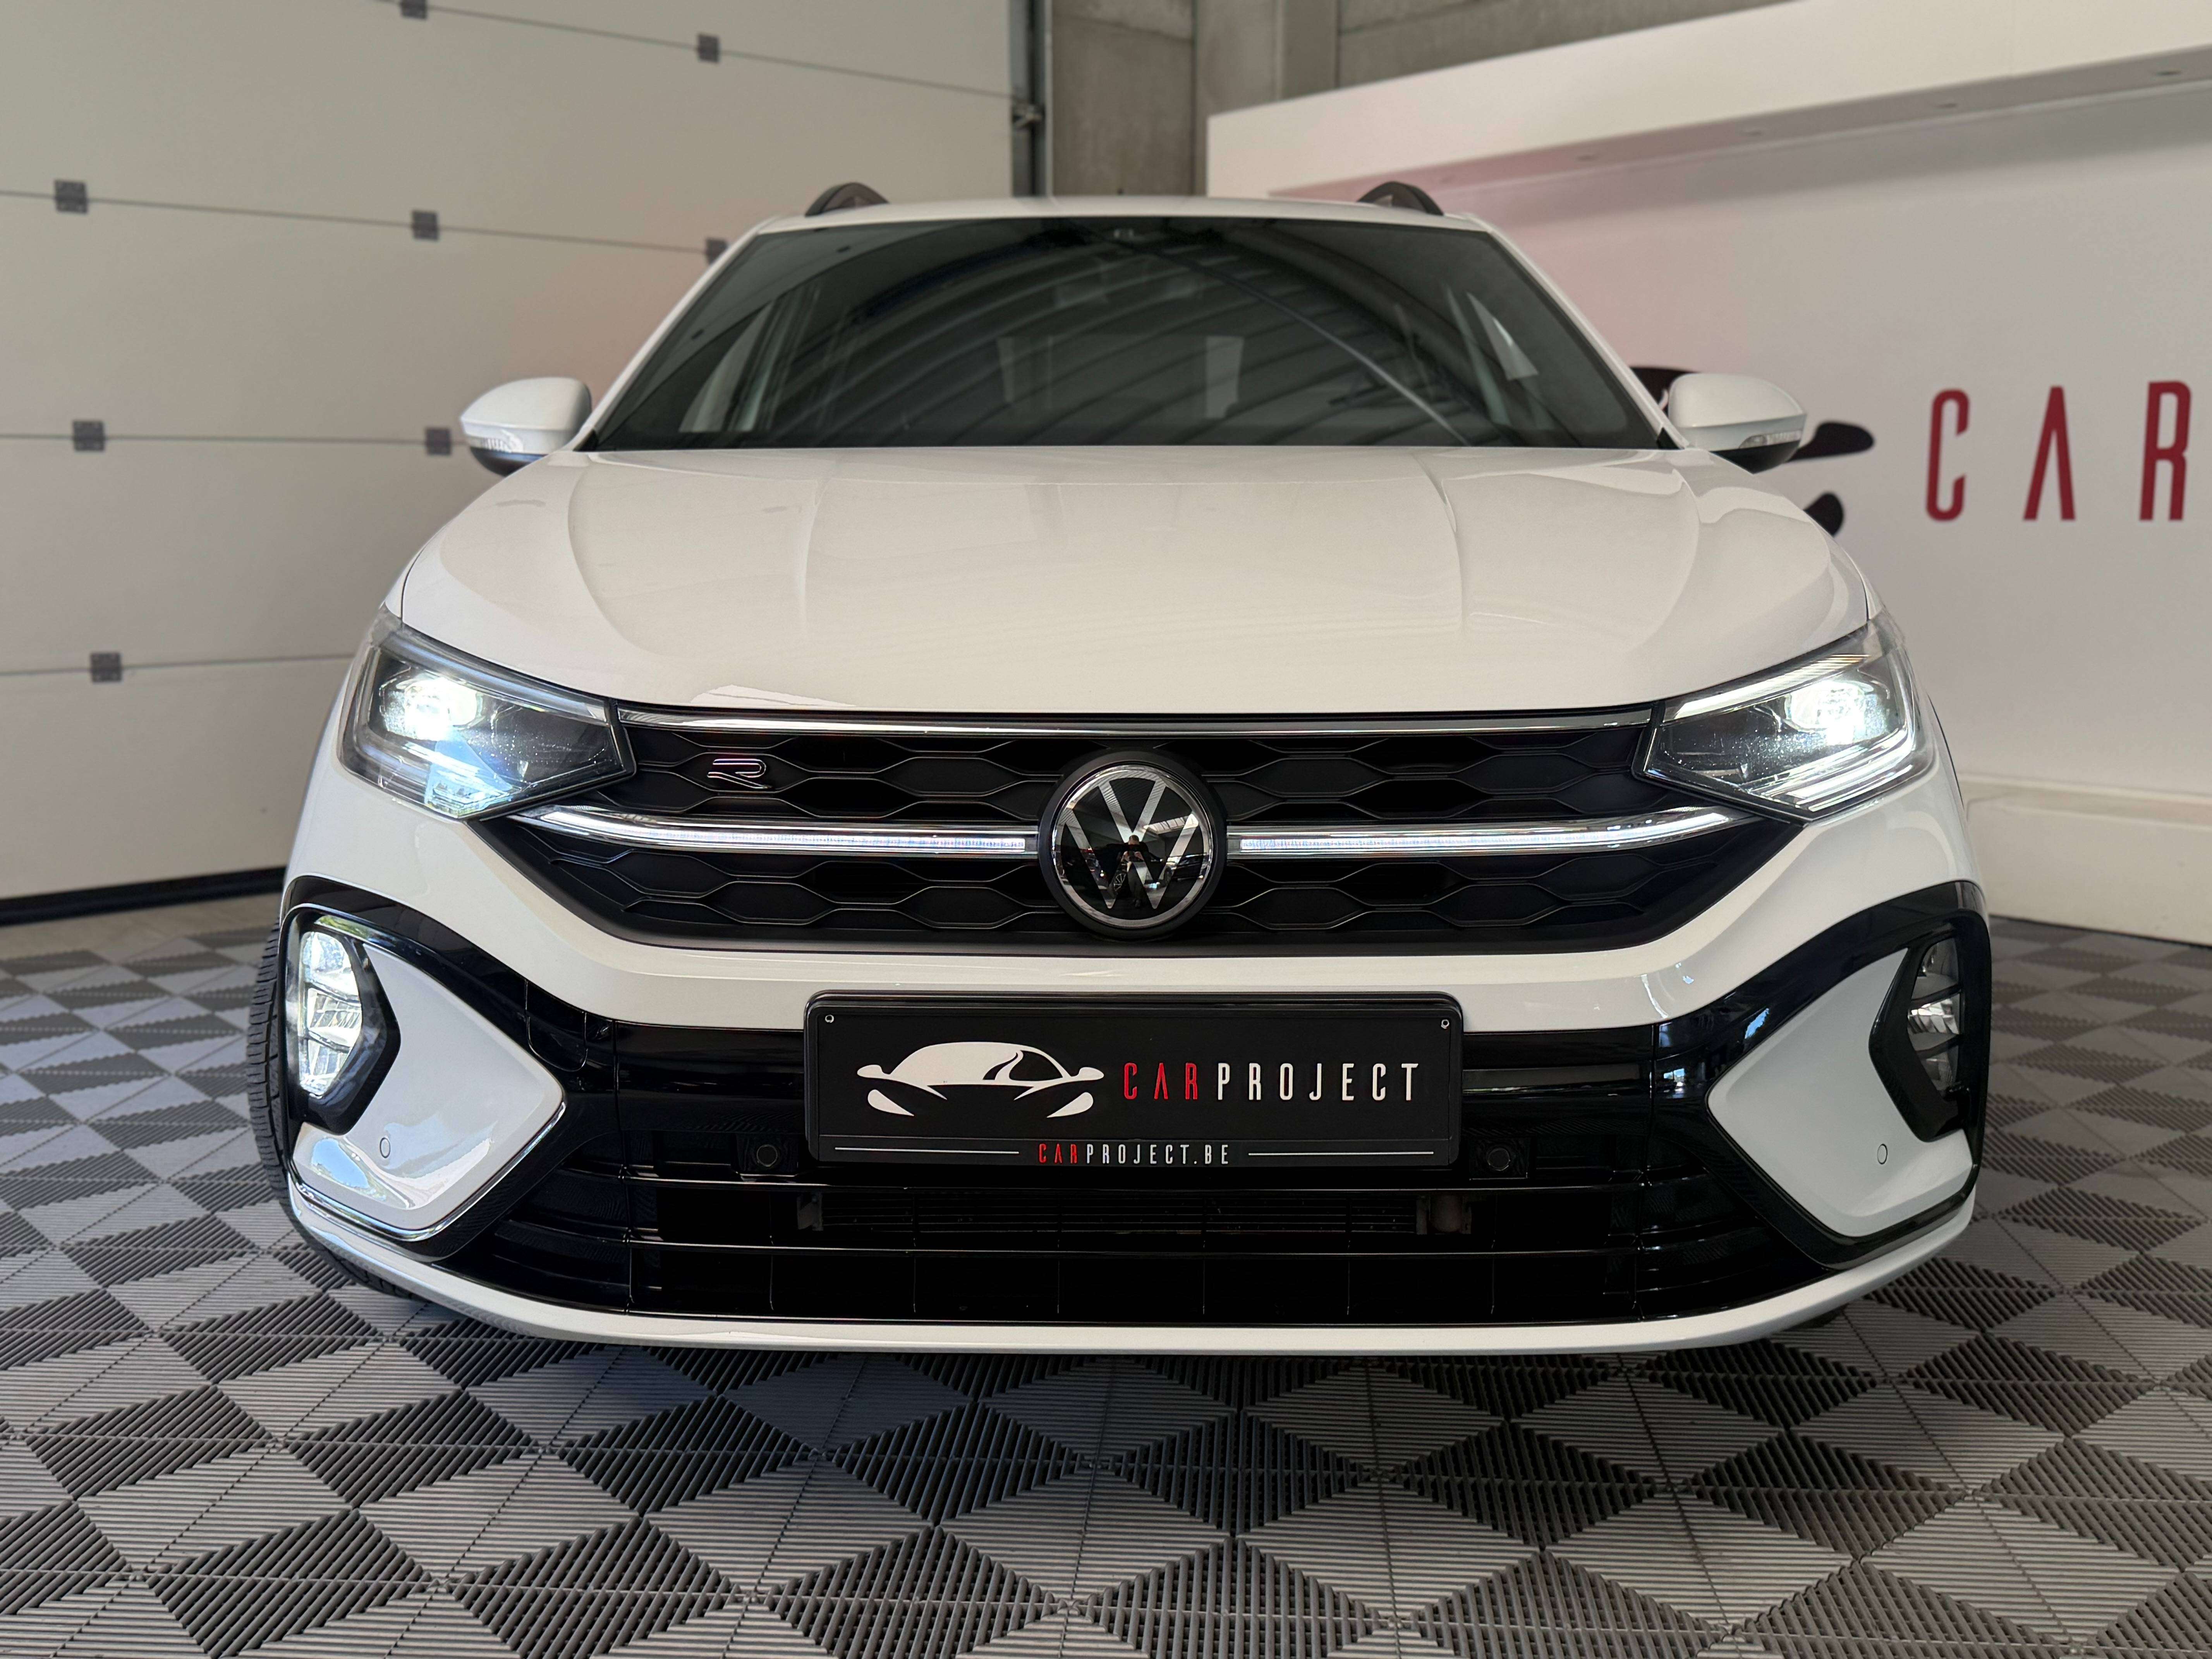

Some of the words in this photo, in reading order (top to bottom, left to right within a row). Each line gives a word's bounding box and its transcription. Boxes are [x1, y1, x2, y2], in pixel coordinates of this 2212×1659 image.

[1926, 381, 2192, 522] CAR
[707, 758, 771, 789] R
[1056, 769, 1205, 915] VW
[1038, 1143, 1229, 1164] CARPROJECT.BE
